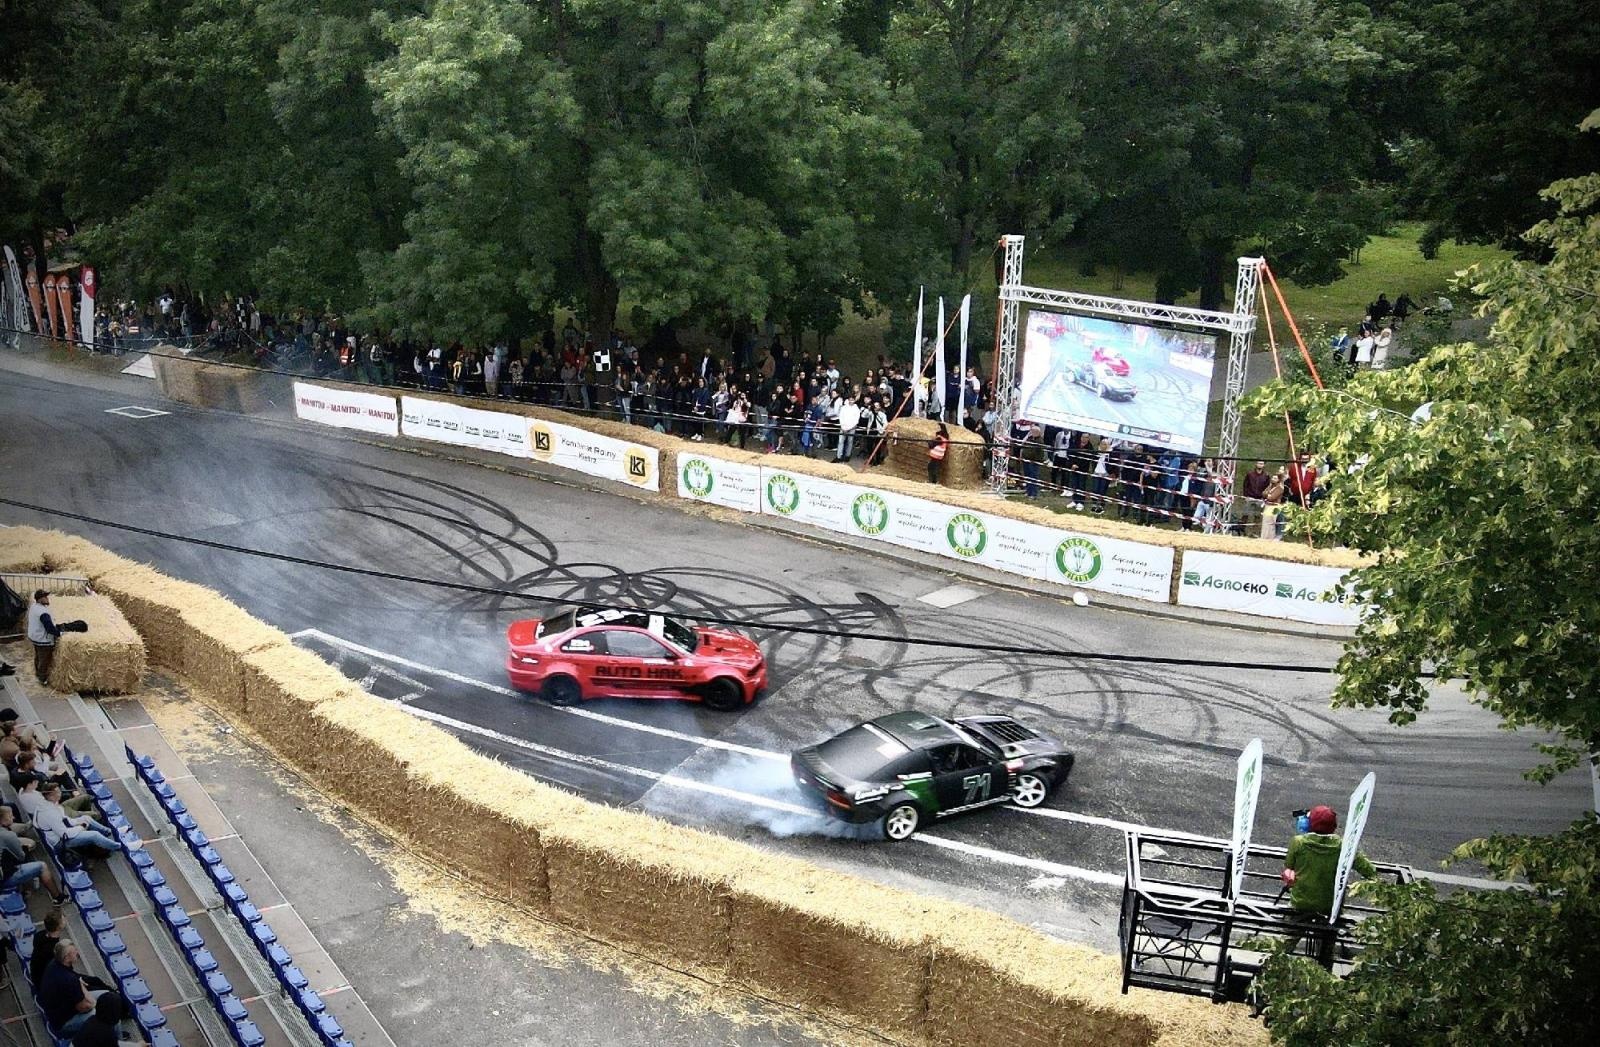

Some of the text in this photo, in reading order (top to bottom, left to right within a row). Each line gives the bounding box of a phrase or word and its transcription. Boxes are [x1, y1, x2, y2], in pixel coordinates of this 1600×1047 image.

[330, 403, 361, 415] MANITOU
[368, 408, 396, 421] MANITOU
[1201, 575, 1269, 595] AGROEKO
[1294, 587, 1351, 605] AGOE
[595, 665, 642, 678] AUTO
